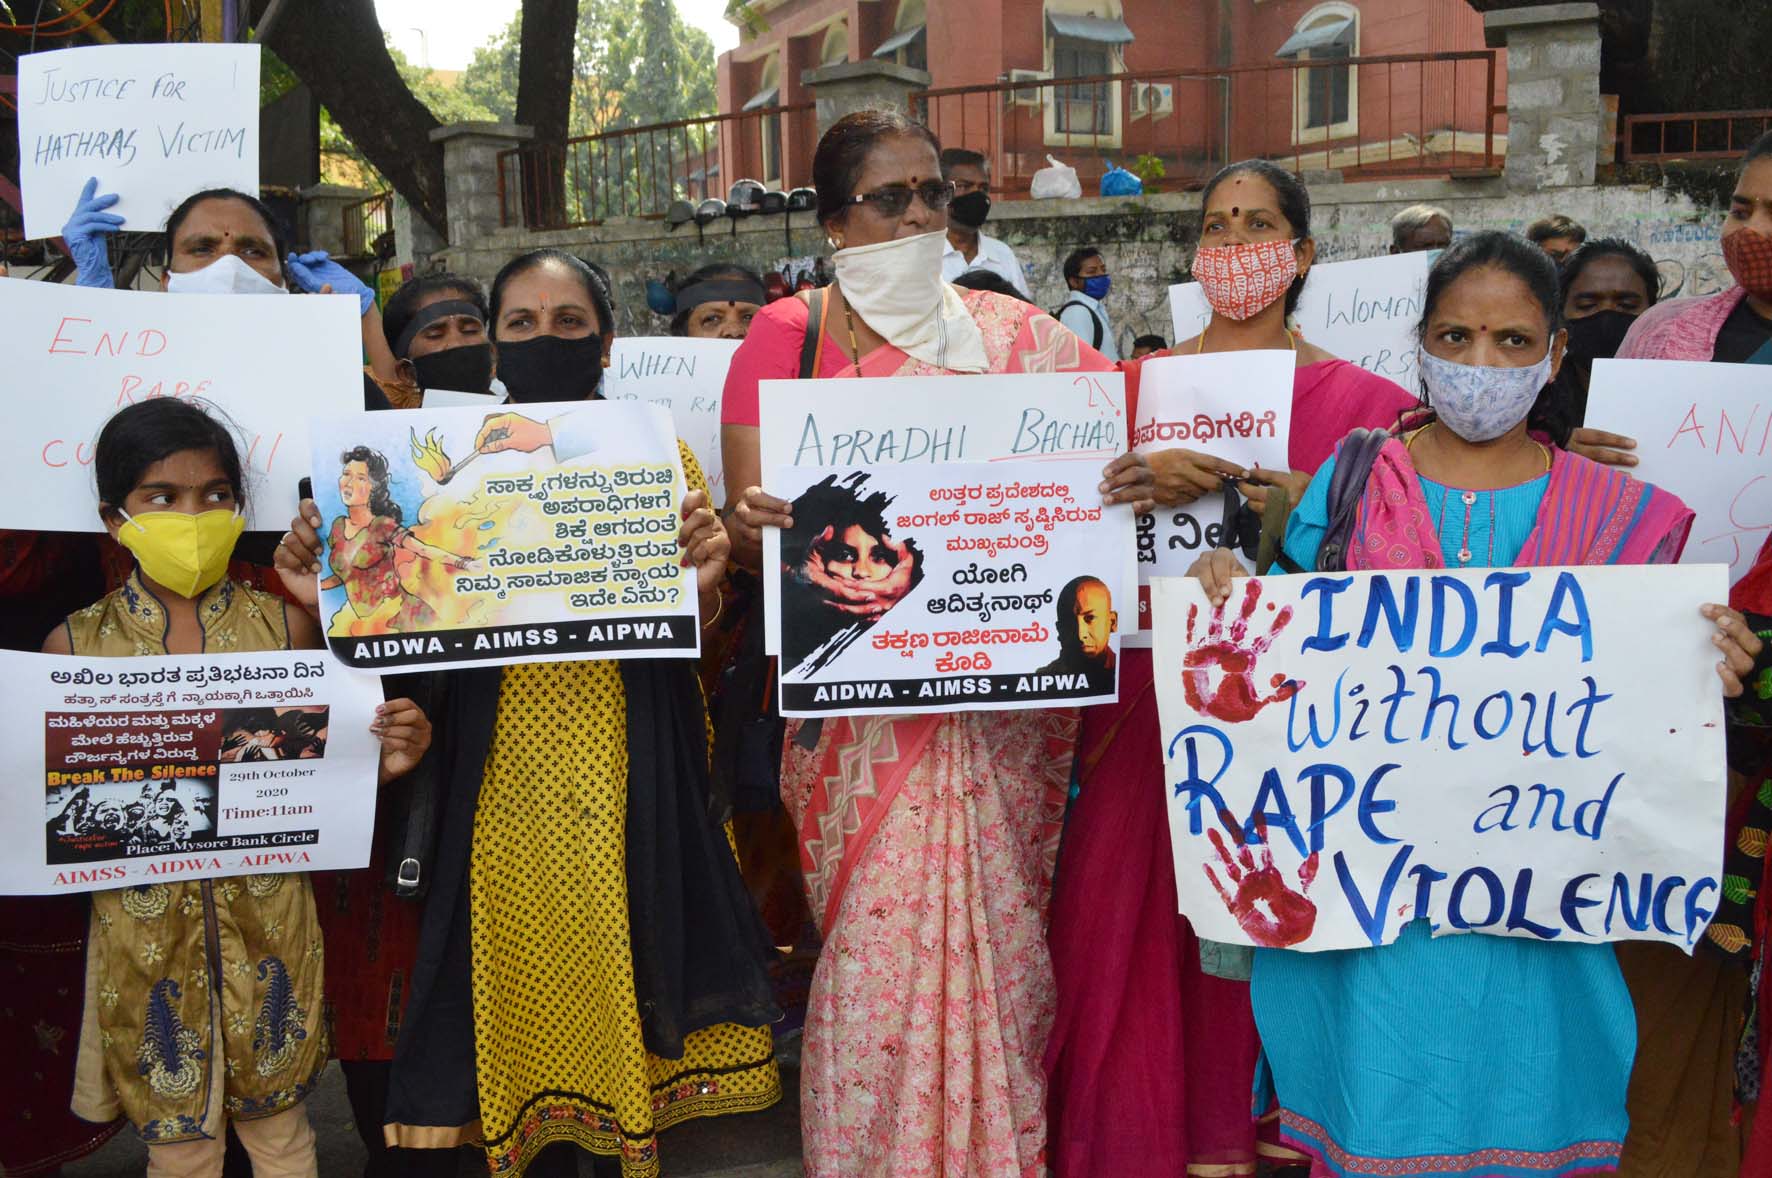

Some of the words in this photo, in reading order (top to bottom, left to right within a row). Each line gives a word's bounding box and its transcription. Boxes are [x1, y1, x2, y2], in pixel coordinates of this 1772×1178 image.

[35, 68, 136, 105] JUSTICE
[152, 73, 187, 100] FOR
[34, 129, 138, 167] HATHRAS
[158, 122, 246, 159] VICTIM
[48, 317, 167, 356] END
[794, 413, 967, 466] APRADHI
[543, 490, 671, 515] ಅಪರಾಧಿಗಳಿಗೆ
[929, 484, 982, 506] ಉತ್ತರ
[986, 482, 1075, 507] ಪ್ರದೇಶದಲ್ಲಿ
[555, 519, 593, 545] ಶಿಕ್ಷೆ
[594, 514, 676, 537] ಆಗದಂತೆ
[897, 510, 960, 528] ಜಂಗಲ್
[964, 508, 1010, 525] ರಾಜ್
[1015, 505, 1101, 532] ಸೃಷ್ಟಿಸಿರುವ
[946, 534, 1049, 558] ಮುಖ್ಯಮಂತ್ರಿ
[613, 563, 679, 588] ನ್ಯಾಯ
[953, 563, 1027, 585] ಯೋಗಿ
[571, 589, 616, 607] ಇದೇ
[927, 589, 1052, 622] ಆದಿತ್ಯನಾಥ್
[1300, 571, 1593, 663] INDIA
[354, 638, 444, 660] AIDWA
[474, 629, 558, 651] AIMSS
[588, 622, 674, 643] AIPWA
[872, 629, 928, 658] ತಕ್ಷಣ
[933, 621, 1049, 647] ರಾಜೀನಾಮೆ
[51, 668, 113, 685] ಅಖಿಲ
[119, 666, 181, 687] ಭಾರತ
[187, 665, 288, 687] ಪ್ರತಿಭಟನಾ
[294, 661, 325, 680] ದಿನ
[936, 651, 992, 673] ಕೊಡಿ
[814, 684, 893, 702] AIDWA
[918, 678, 992, 698] AIMSS
[1016, 674, 1089, 692] AIPWA
[49, 713, 129, 729] ಮಹಿಳೆಯರ
[132, 713, 169, 730] ಮತ್ತು
[171, 711, 216, 729] ಮಕ್ಕಳ
[71, 733, 115, 746] ಮೇಲೆ
[48, 769, 105, 786] Break
[111, 767, 144, 782] The
[151, 764, 217, 781] Silence
[229, 771, 260, 782] 29th
[263, 768, 317, 779] October
[256, 788, 288, 798] 2020
[1168, 725, 1406, 859] RAPE
[1473, 772, 1624, 840] and
[126, 843, 171, 855] Place:
[174, 838, 228, 852] Mysore
[232, 834, 268, 847] Bank
[272, 832, 315, 844] Circle
[53, 865, 127, 885] AIMSS
[144, 859, 222, 876] AIDWA
[239, 851, 312, 867] AIPWA
